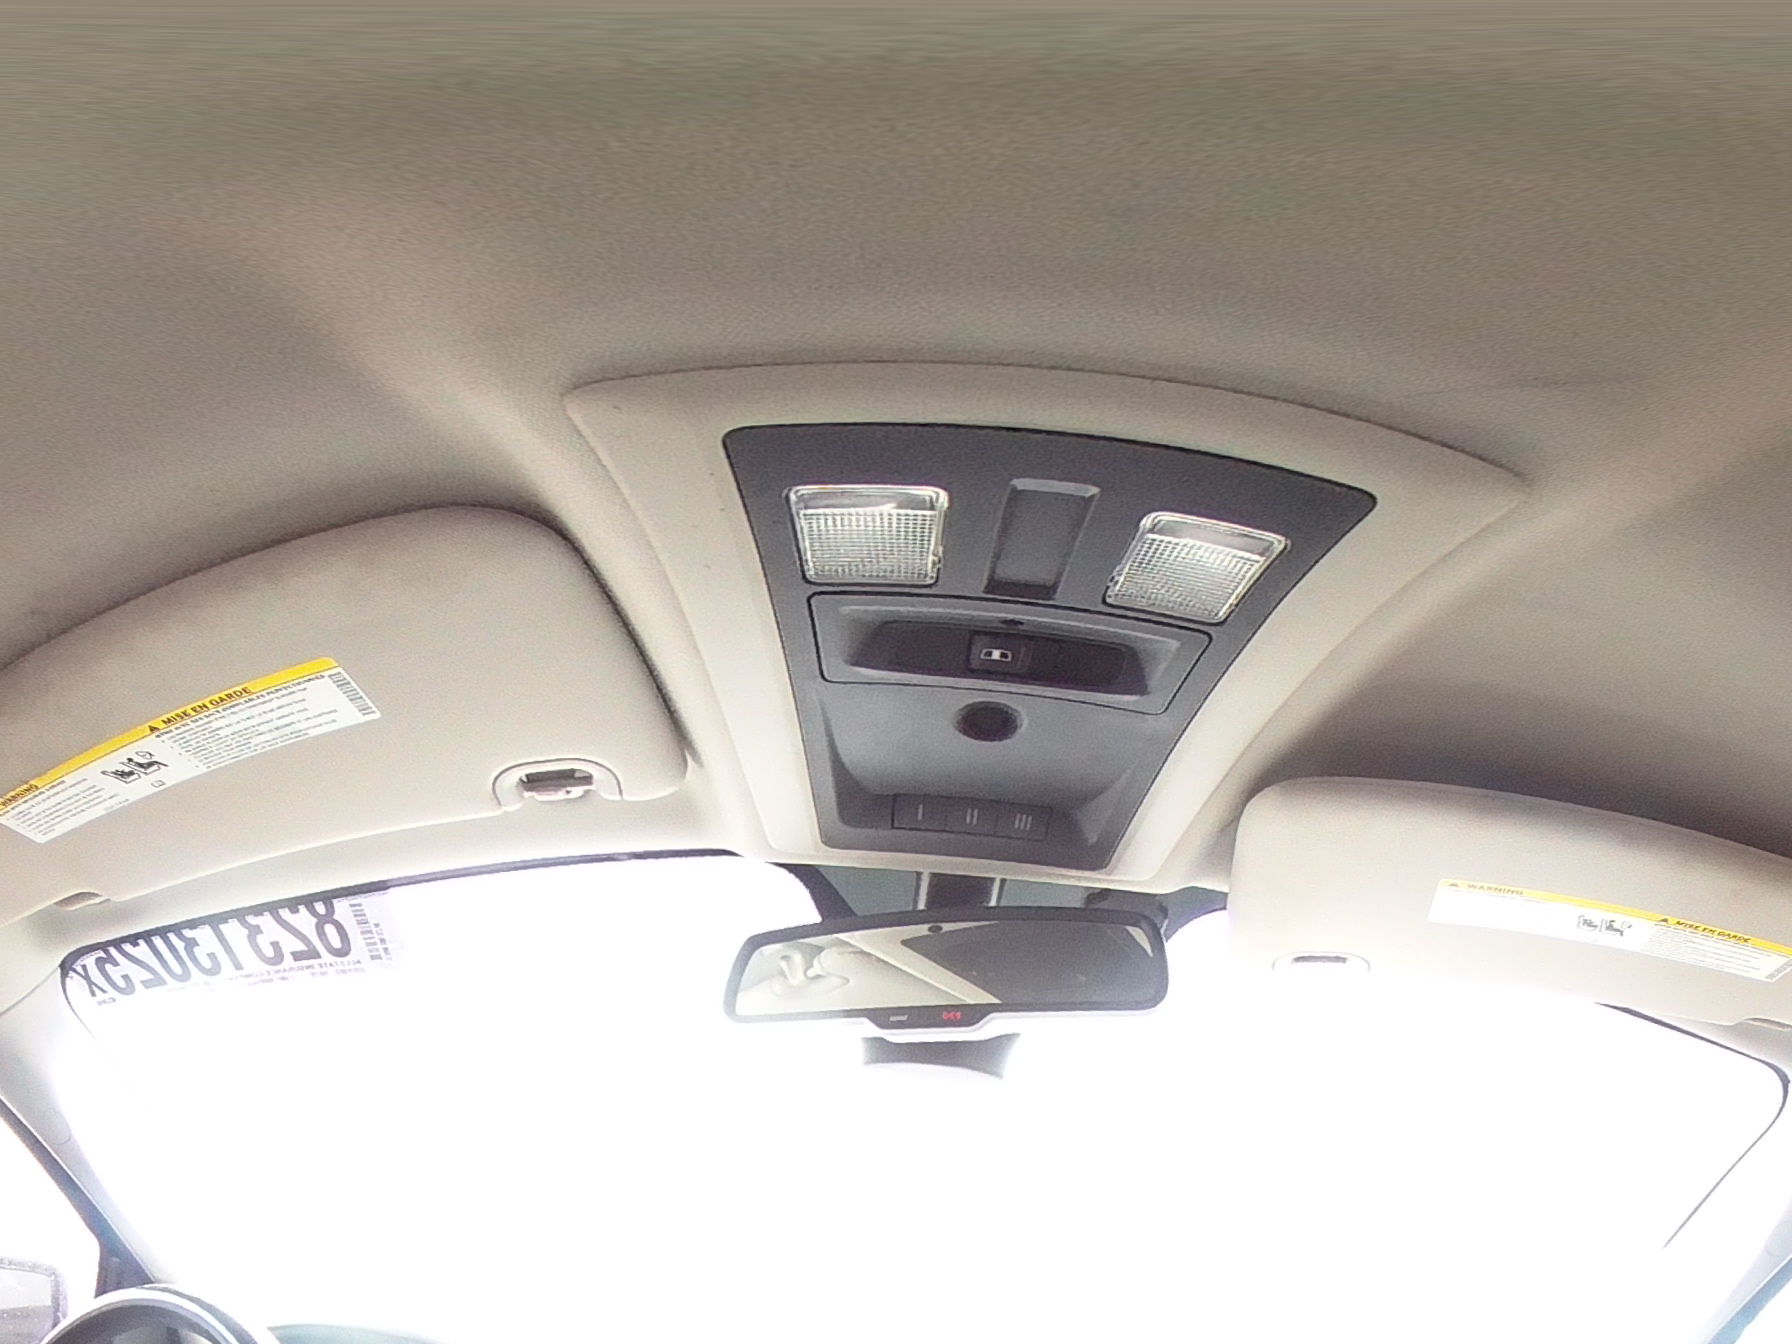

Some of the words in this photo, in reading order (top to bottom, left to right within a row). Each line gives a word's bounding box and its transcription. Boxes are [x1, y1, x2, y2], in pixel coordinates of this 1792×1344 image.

[160, 708, 191, 727] MISE
[192, 702, 210, 715] EN
[208, 686, 253, 708] GARDE
[1466, 882, 1525, 897] WARNING
[1675, 919, 1702, 932] MISE
[1716, 930, 1753, 944] GARDE
